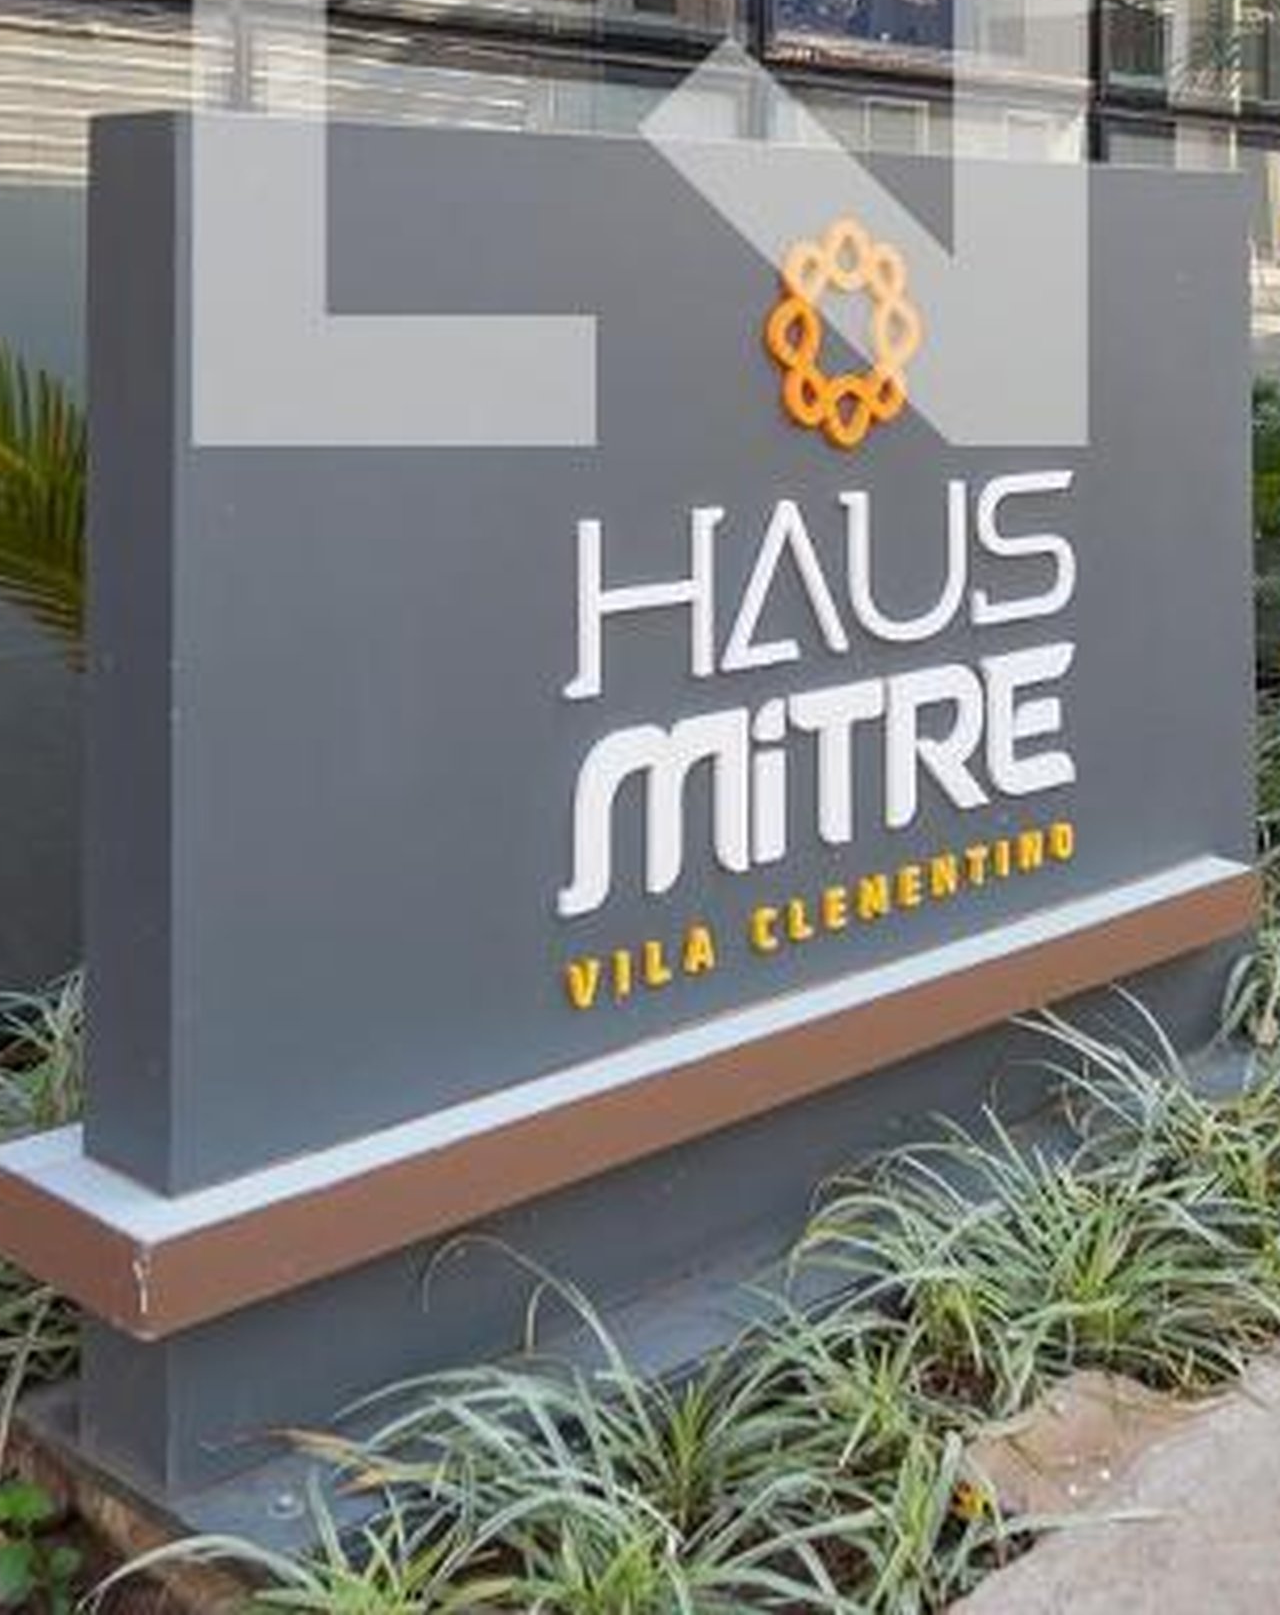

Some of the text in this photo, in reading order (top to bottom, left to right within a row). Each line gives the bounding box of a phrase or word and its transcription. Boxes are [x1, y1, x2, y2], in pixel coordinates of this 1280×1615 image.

[561, 470, 1078, 700] HAUS
[564, 821, 1077, 1011] VILA CLEMENTINO
